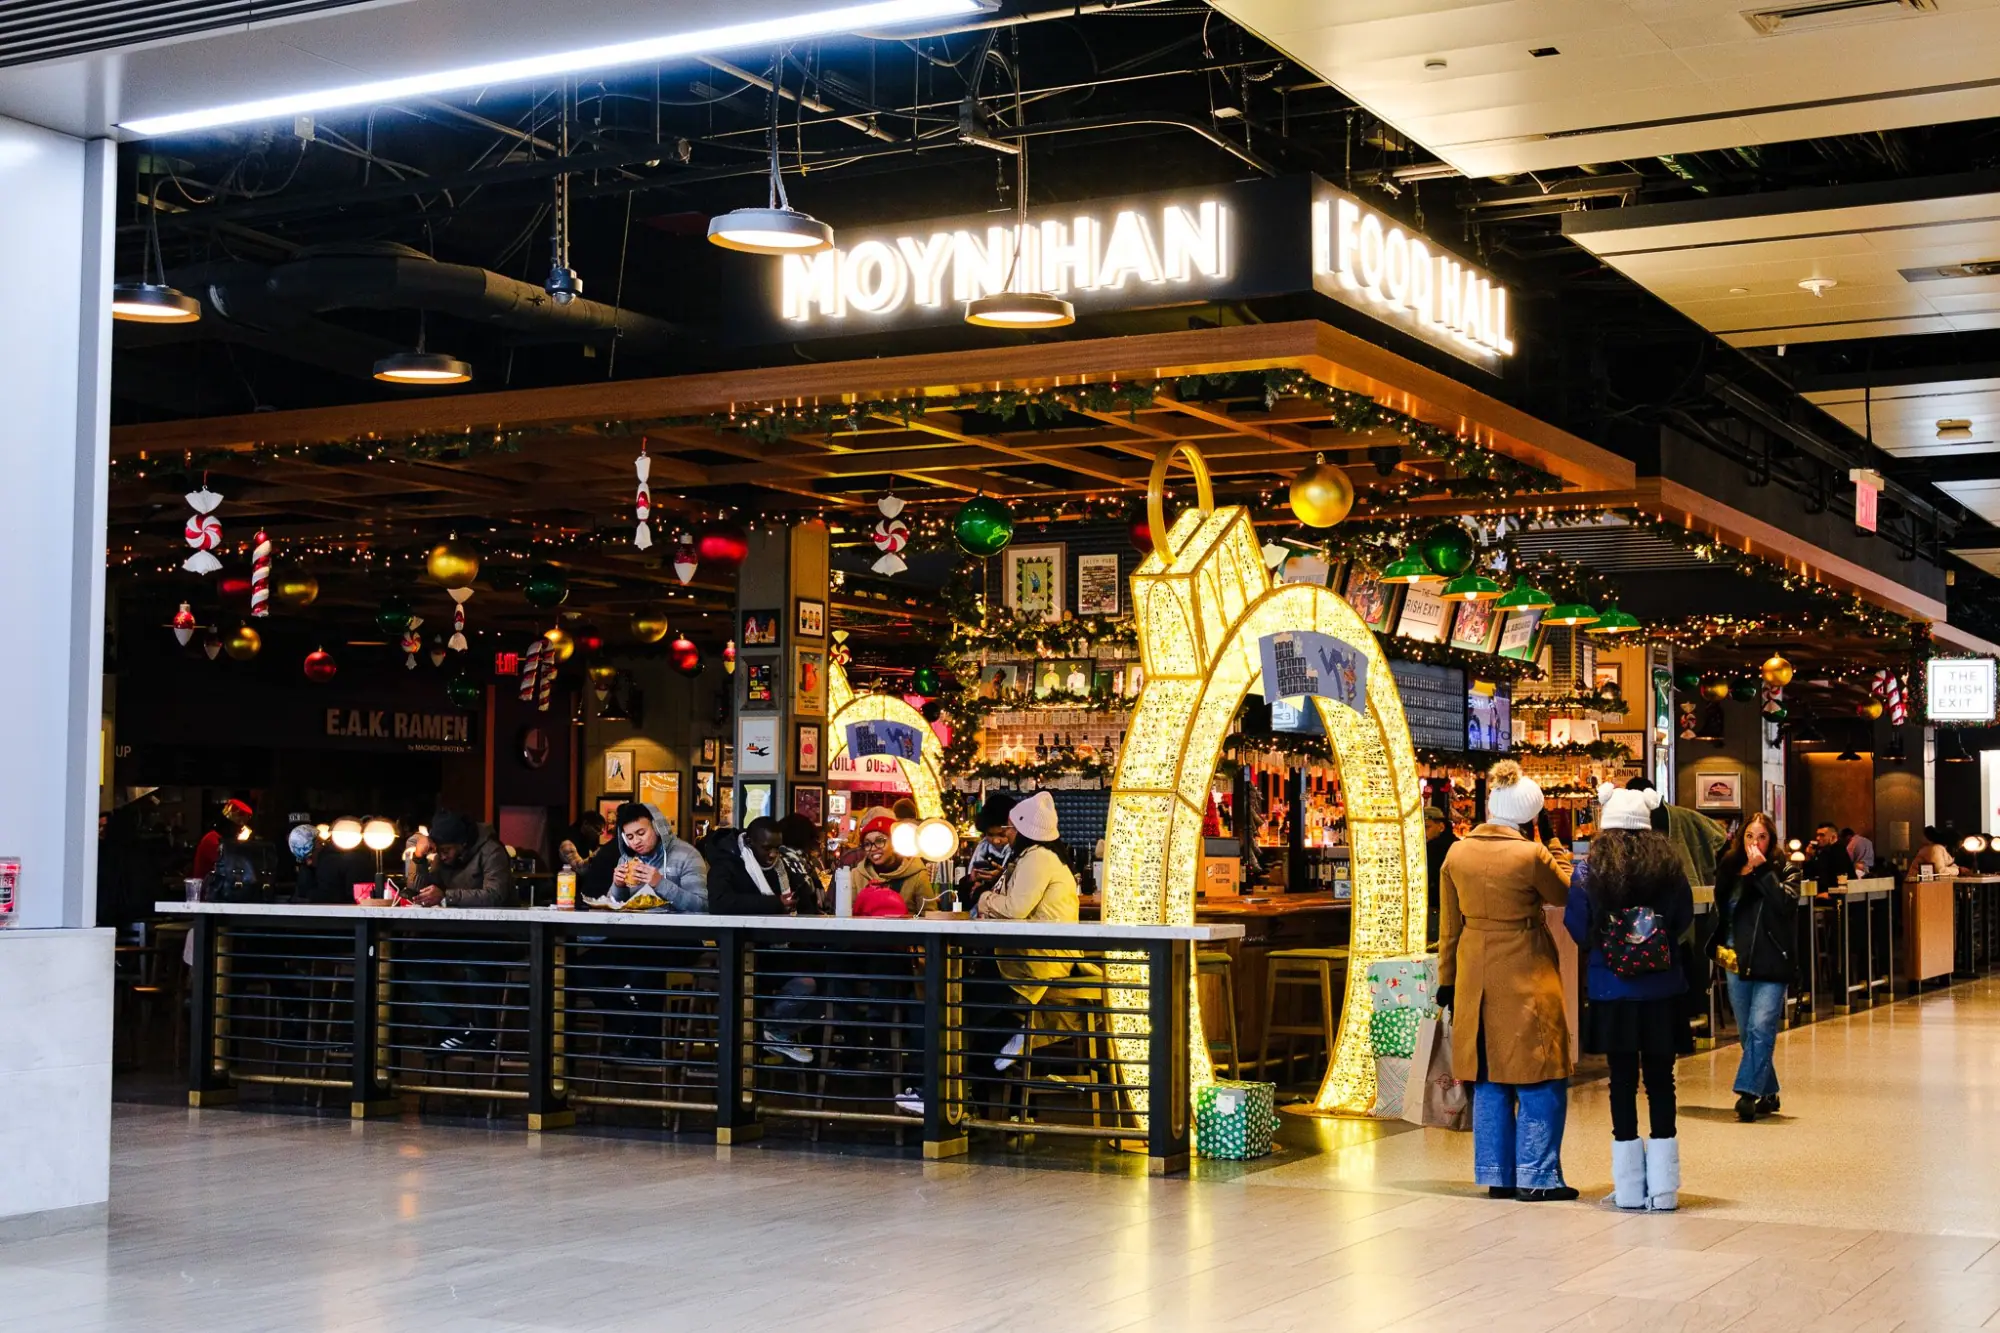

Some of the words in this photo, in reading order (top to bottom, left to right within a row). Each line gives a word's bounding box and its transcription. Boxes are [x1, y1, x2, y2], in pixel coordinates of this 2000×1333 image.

[782, 202, 1228, 321] MOYNIHAN
[1338, 198, 1434, 322] FOOD
[1438, 255, 1514, 355] HALL
[1420, 588, 1432, 598] THE
[1405, 599, 1423, 615] RISH
[1423, 602, 1441, 617] EXIT
[1949, 671, 1977, 680] THE
[1943, 685, 1983, 695] IRISH
[1938, 698, 1971, 708] EXIT
[326, 708, 389, 738] E.A.K.
[394, 712, 468, 742] RAMEN
[116, 745, 132, 758] UP
[830, 757, 857, 773] UILA
[1613, 769, 1639, 778] ARNING
[0, 877, 13, 886] IRE
